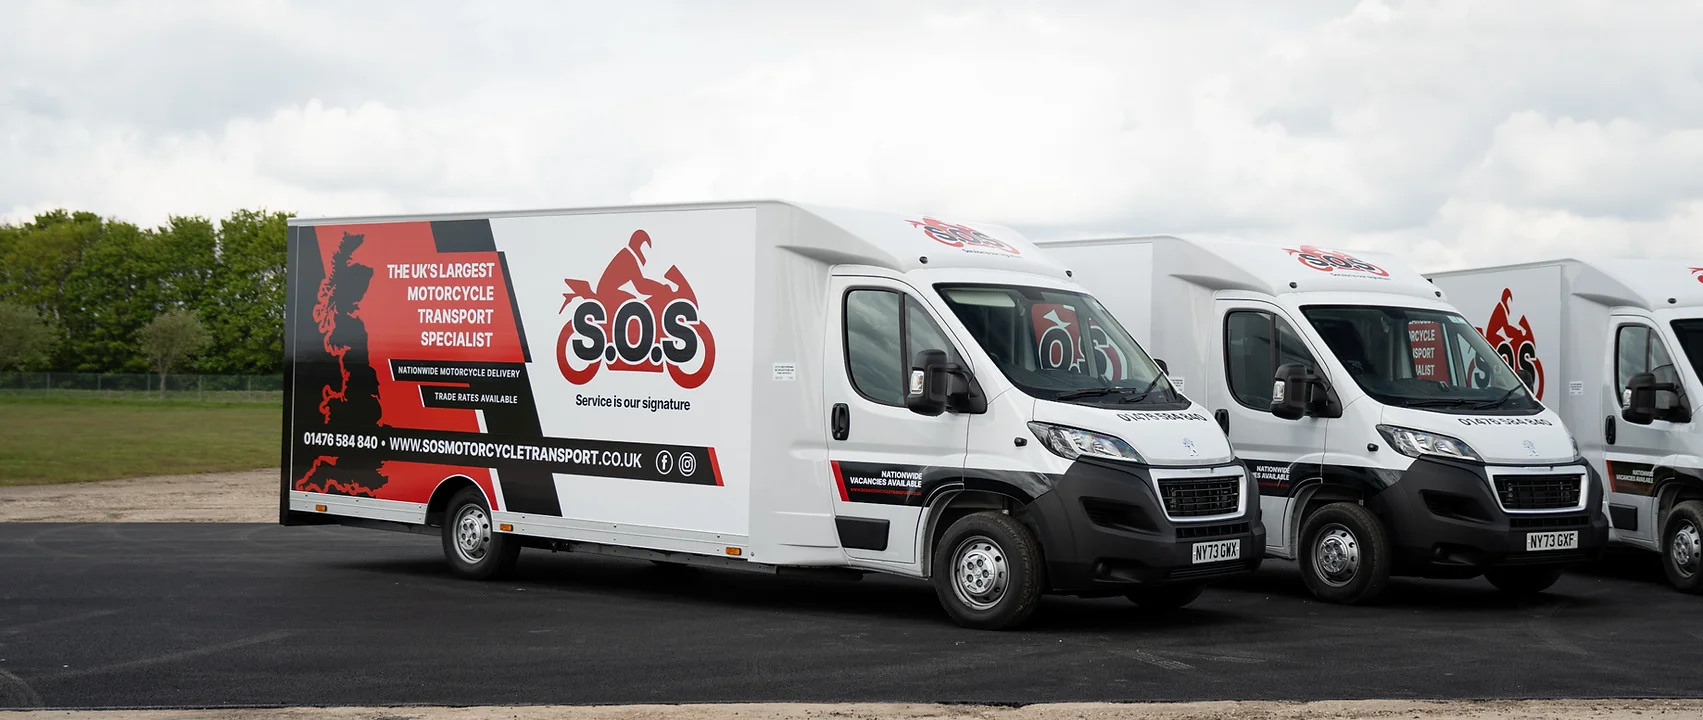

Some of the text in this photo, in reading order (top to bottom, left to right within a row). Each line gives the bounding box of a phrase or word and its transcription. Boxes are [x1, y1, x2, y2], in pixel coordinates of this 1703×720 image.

[387, 262, 495, 279] THE UK'S LARGEST
[407, 286, 494, 301] MOTORCYCLE
[417, 309, 494, 324] TRANSPORT
[421, 331, 493, 348] SPECIALIST
[571, 300, 699, 364] S.O.S
[398, 366, 520, 378] NATIONWIDE MOTORCYCLE DELIVERY
[435, 392, 518, 404] TRADE RATES AVAILABLE
[575, 393, 691, 412] Service is our signature
[303, 431, 642, 468] 01476 584 840 WWW.SOSMOTORCYCLETRANSPORT.CO.UK
[849, 476, 922, 488] VACANCIES AVAILABLE
[881, 470, 923, 480] NATIONWIDE
[1531, 533, 1574, 548] NY73 GXF
[1196, 541, 1236, 560] NY73 GWX
